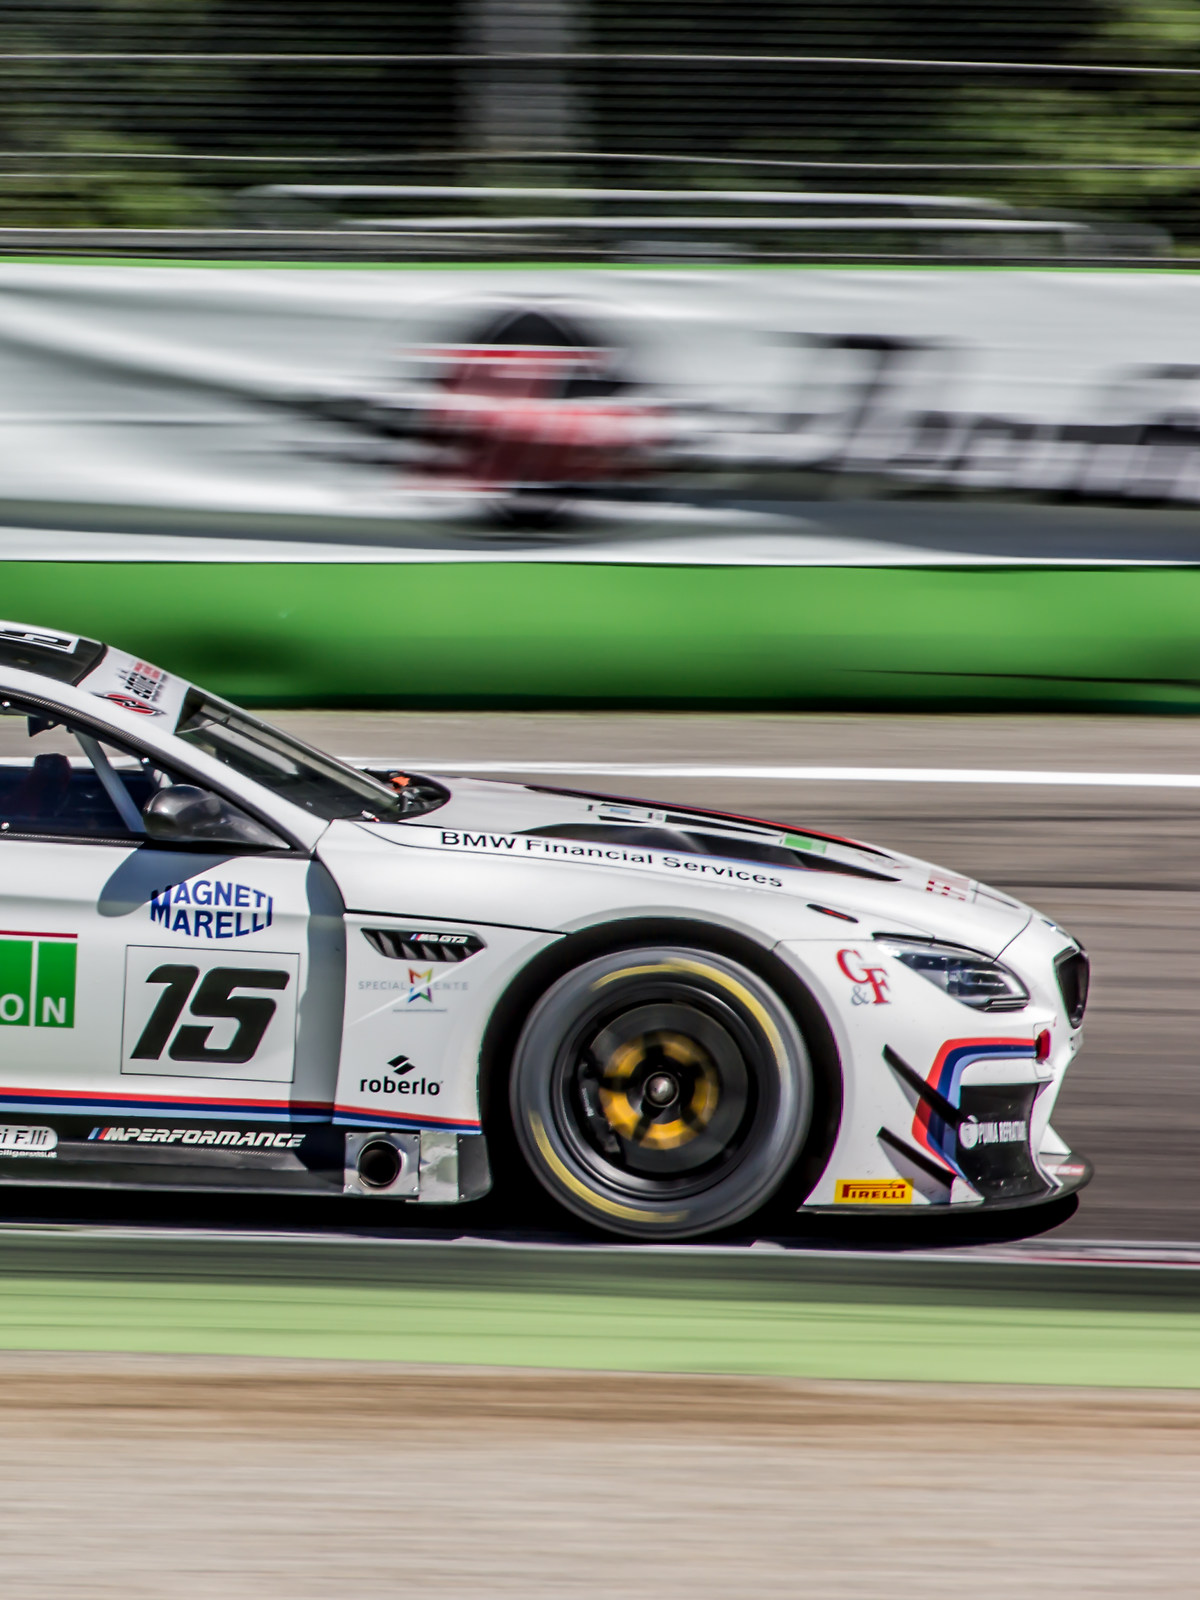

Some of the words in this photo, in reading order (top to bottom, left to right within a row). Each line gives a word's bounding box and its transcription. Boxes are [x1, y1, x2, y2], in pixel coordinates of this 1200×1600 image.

[441, 831, 516, 849] BMW
[526, 838, 653, 864] Financial
[662, 856, 783, 888] Services
[150, 880, 274, 910] MAGNETI
[150, 906, 273, 939] MARELLI
[130, 963, 290, 1064] 15
[360, 1076, 441, 1096] roberlo
[842, 1182, 906, 1199] PIRELLI
